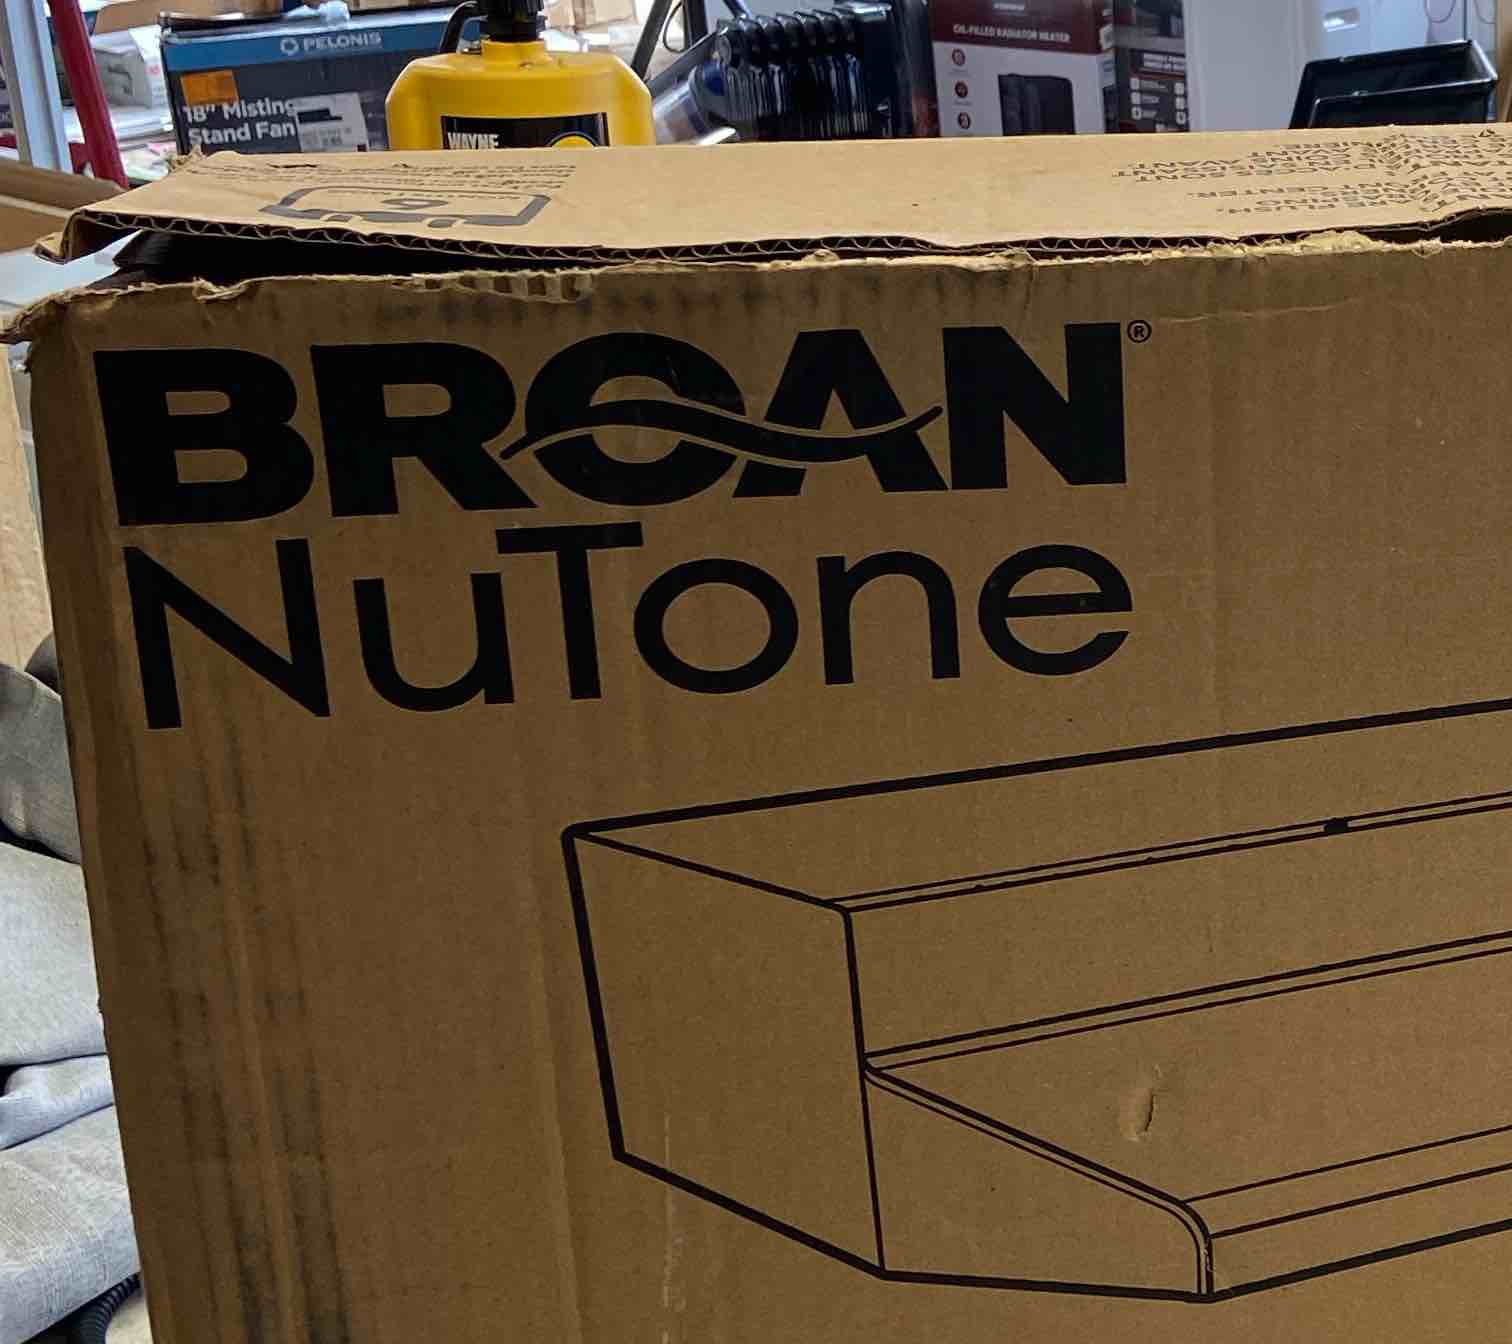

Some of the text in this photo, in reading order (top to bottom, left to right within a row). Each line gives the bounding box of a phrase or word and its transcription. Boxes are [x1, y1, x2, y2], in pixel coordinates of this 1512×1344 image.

[302, 31, 383, 53] PELONIS
[184, 96, 297, 124] 18" Misting
[187, 123, 251, 146] Stand
[256, 120, 297, 140] Fan
[448, 131, 500, 150] WAYNE
[121, 521, 1134, 731] NuTone
